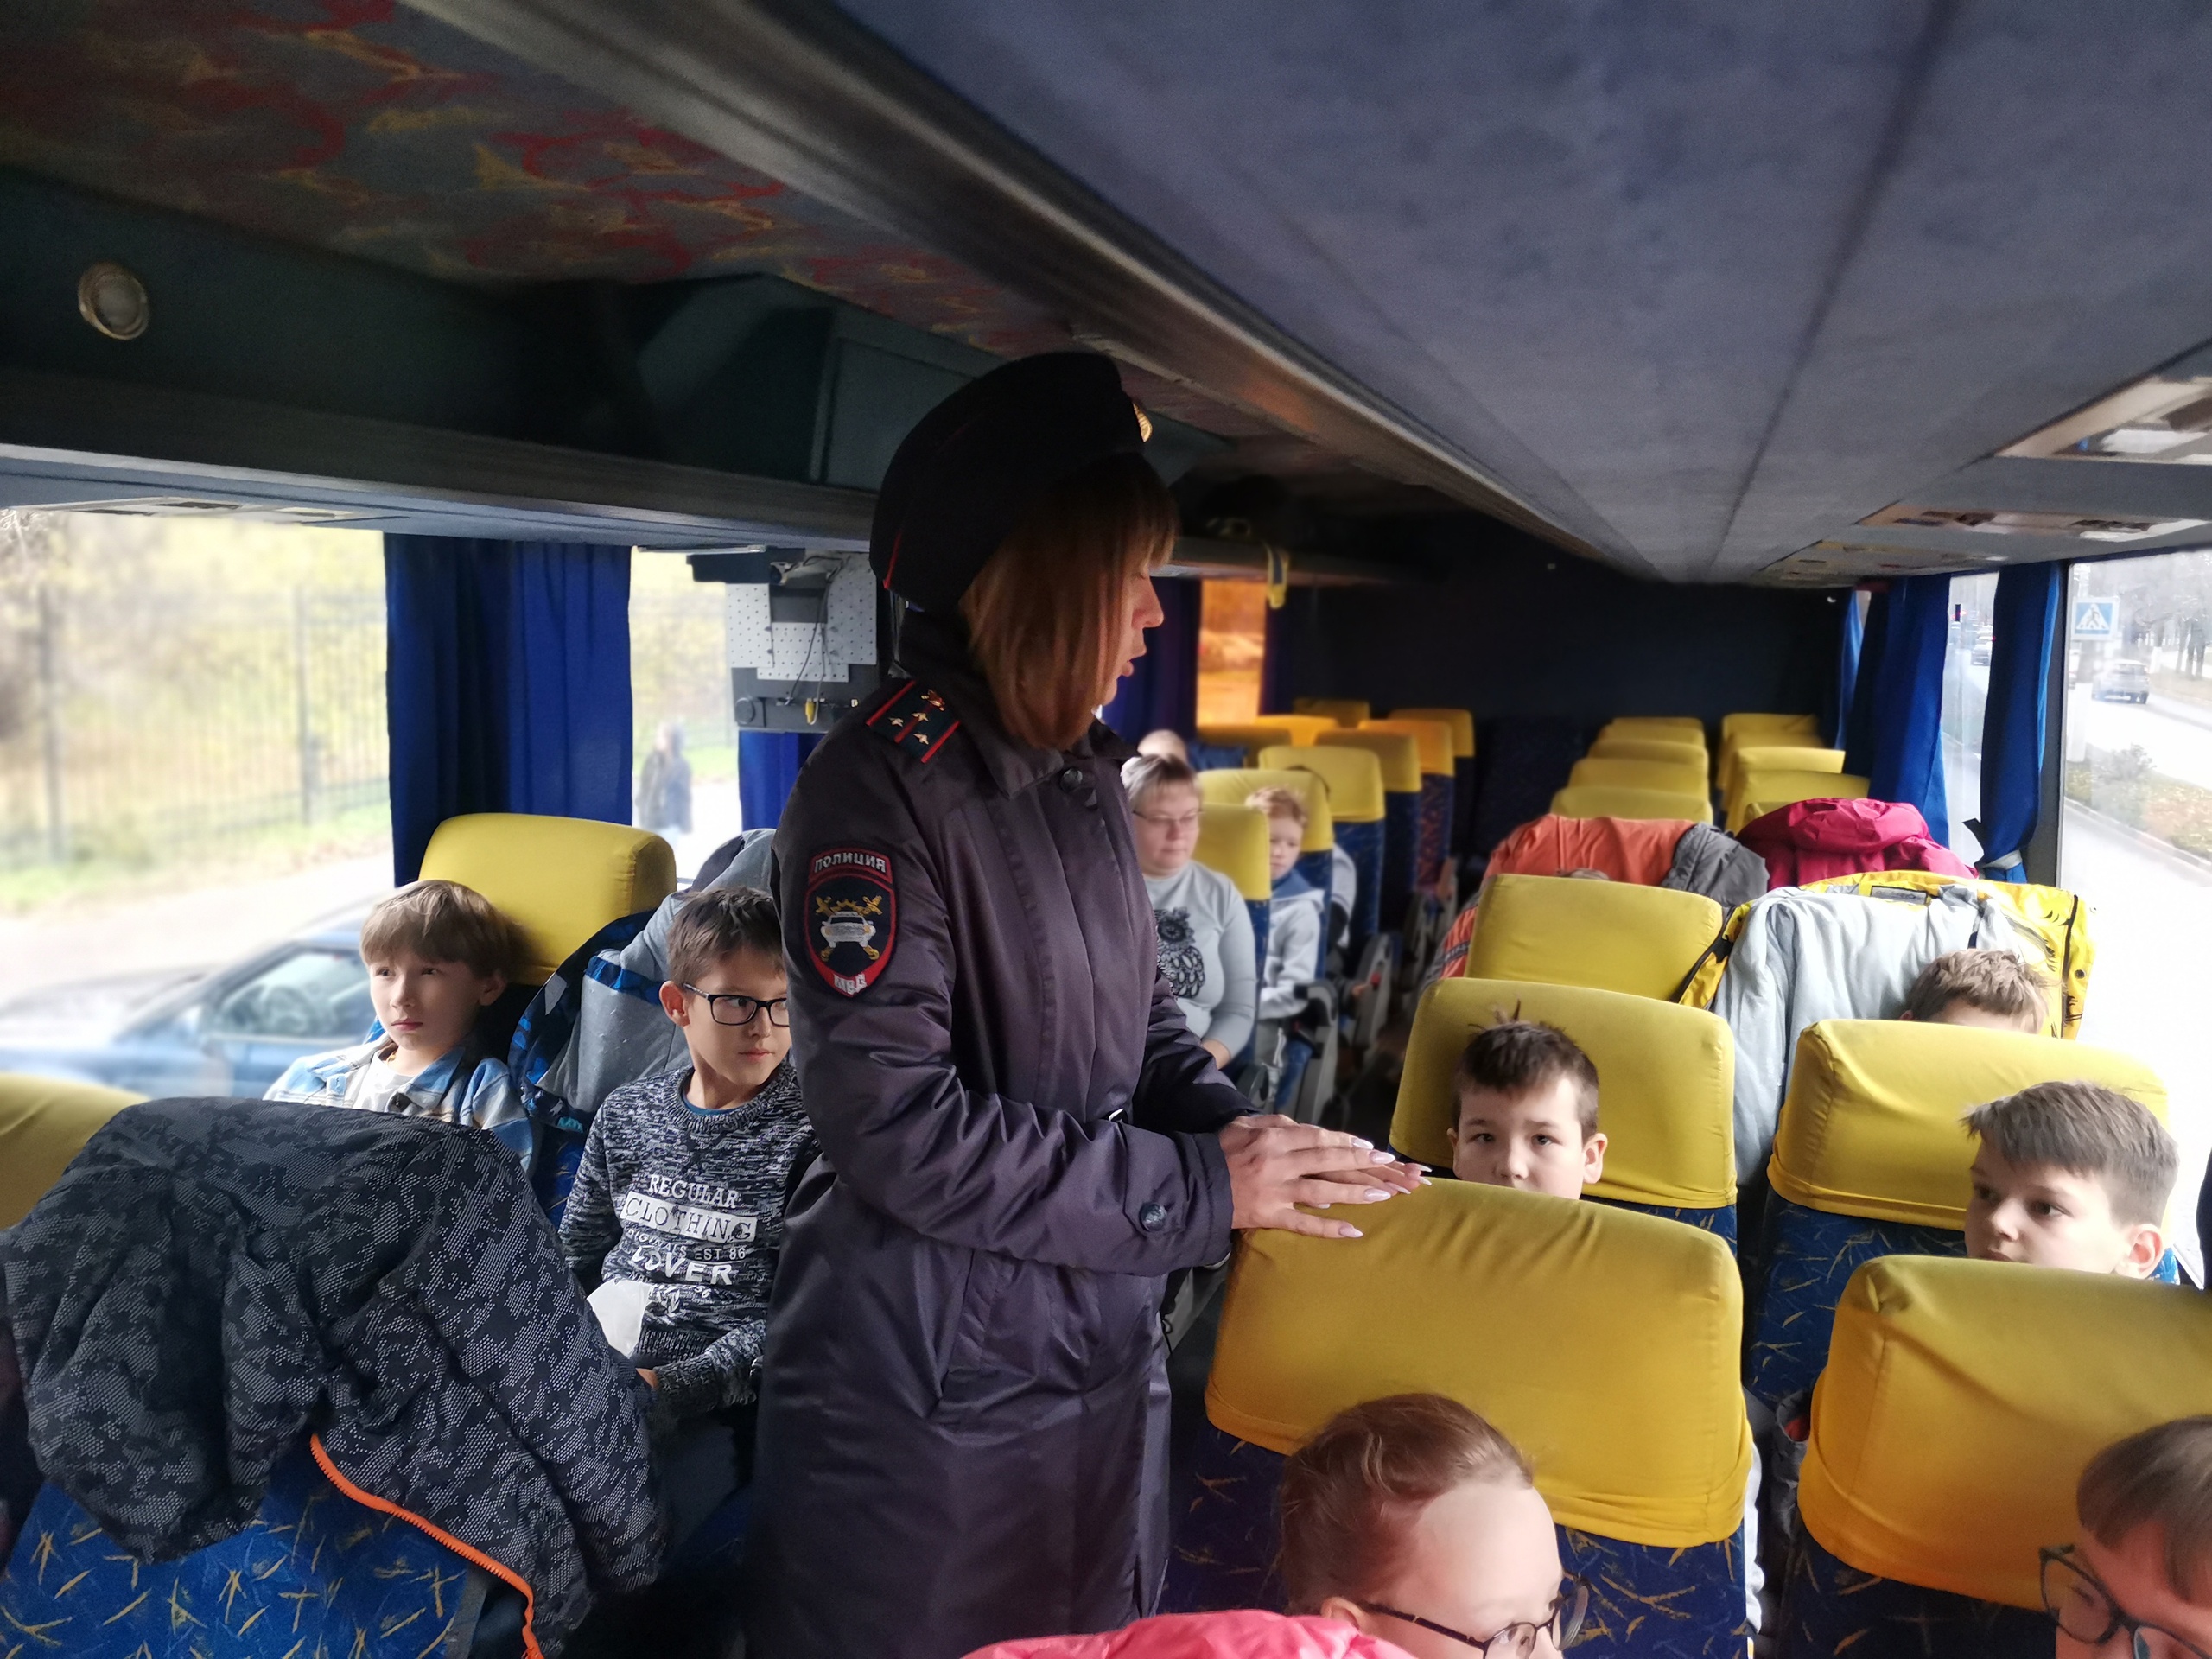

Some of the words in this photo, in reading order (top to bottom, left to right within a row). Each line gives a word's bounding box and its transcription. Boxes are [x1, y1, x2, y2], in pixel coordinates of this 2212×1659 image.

[814, 852, 887, 873] ПОЛИЦИЯ
[833, 972, 868, 995] МВД
[648, 1173, 741, 1209] REGULAR
[625, 1197, 752, 1242] CLOTHING
[631, 1244, 733, 1286] LOVER
[694, 1248, 722, 1261] EST
[728, 1247, 746, 1261] 86
